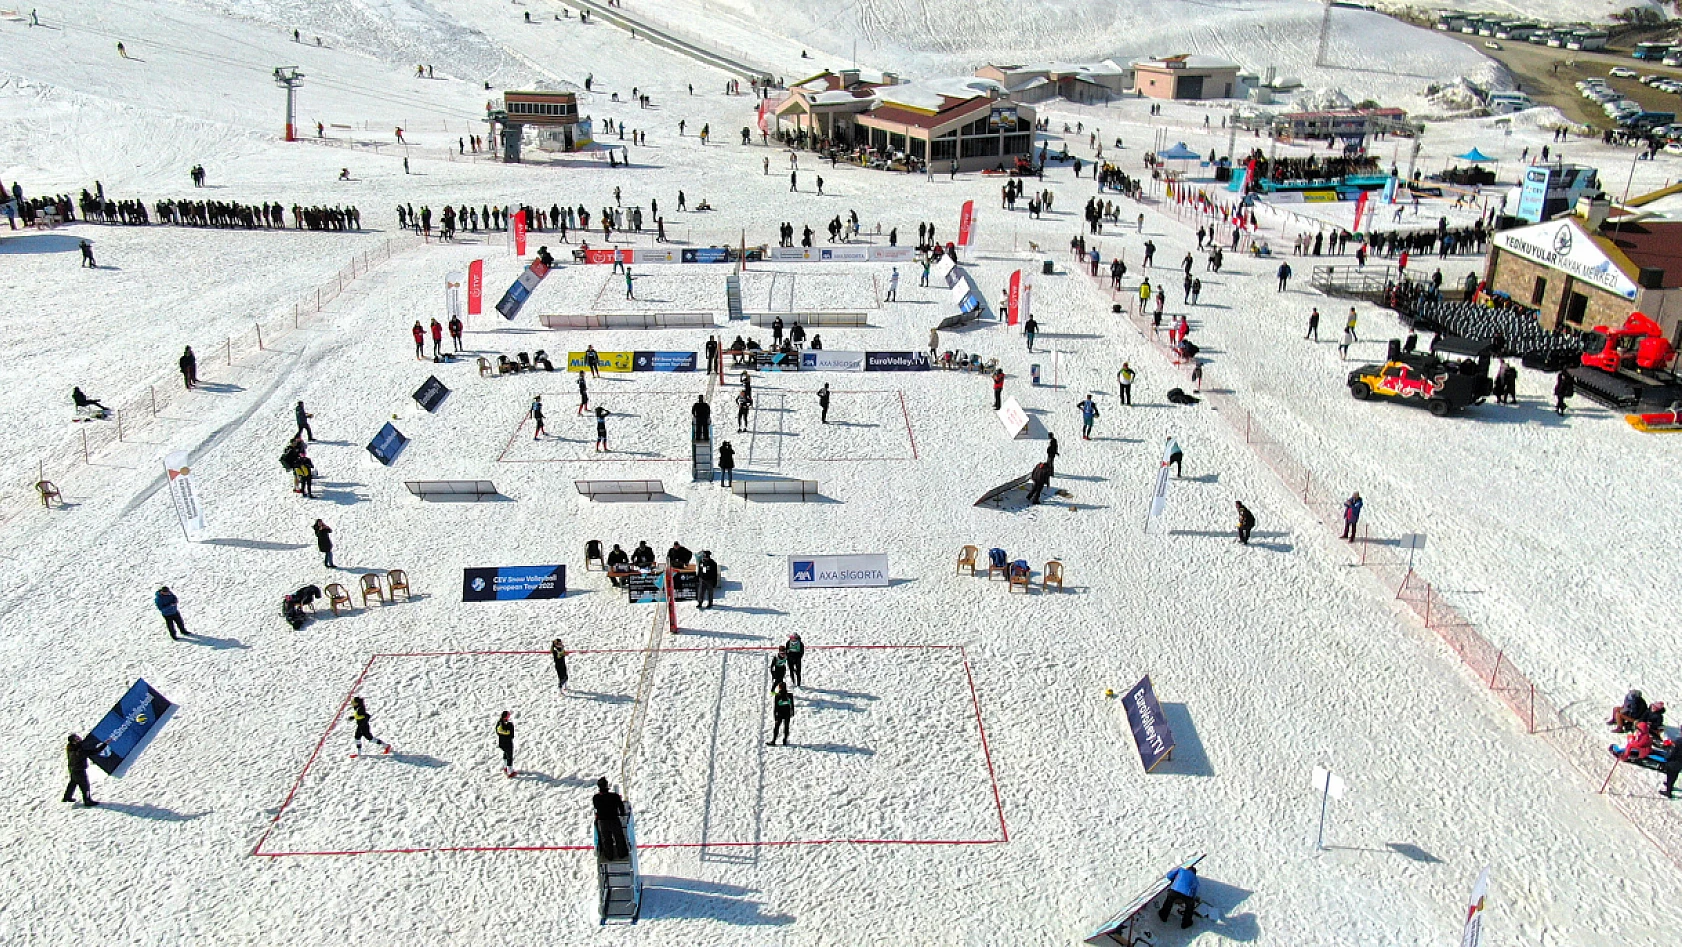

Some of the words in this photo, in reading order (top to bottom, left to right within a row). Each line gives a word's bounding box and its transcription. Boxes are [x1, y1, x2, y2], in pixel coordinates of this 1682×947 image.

[1505, 235, 1557, 265] YEDİKUYULAR
[1557, 253, 1582, 274] KAYAK
[1583, 263, 1619, 288] MERKEZİ
[869, 356, 926, 367] EuroVolley.TV
[526, 573, 558, 584] Volleyball
[819, 570, 838, 581] AXA
[840, 569, 884, 581] SİGORTA
[492, 583, 523, 592] European
[1134, 687, 1165, 756] EuroVolley.TV
